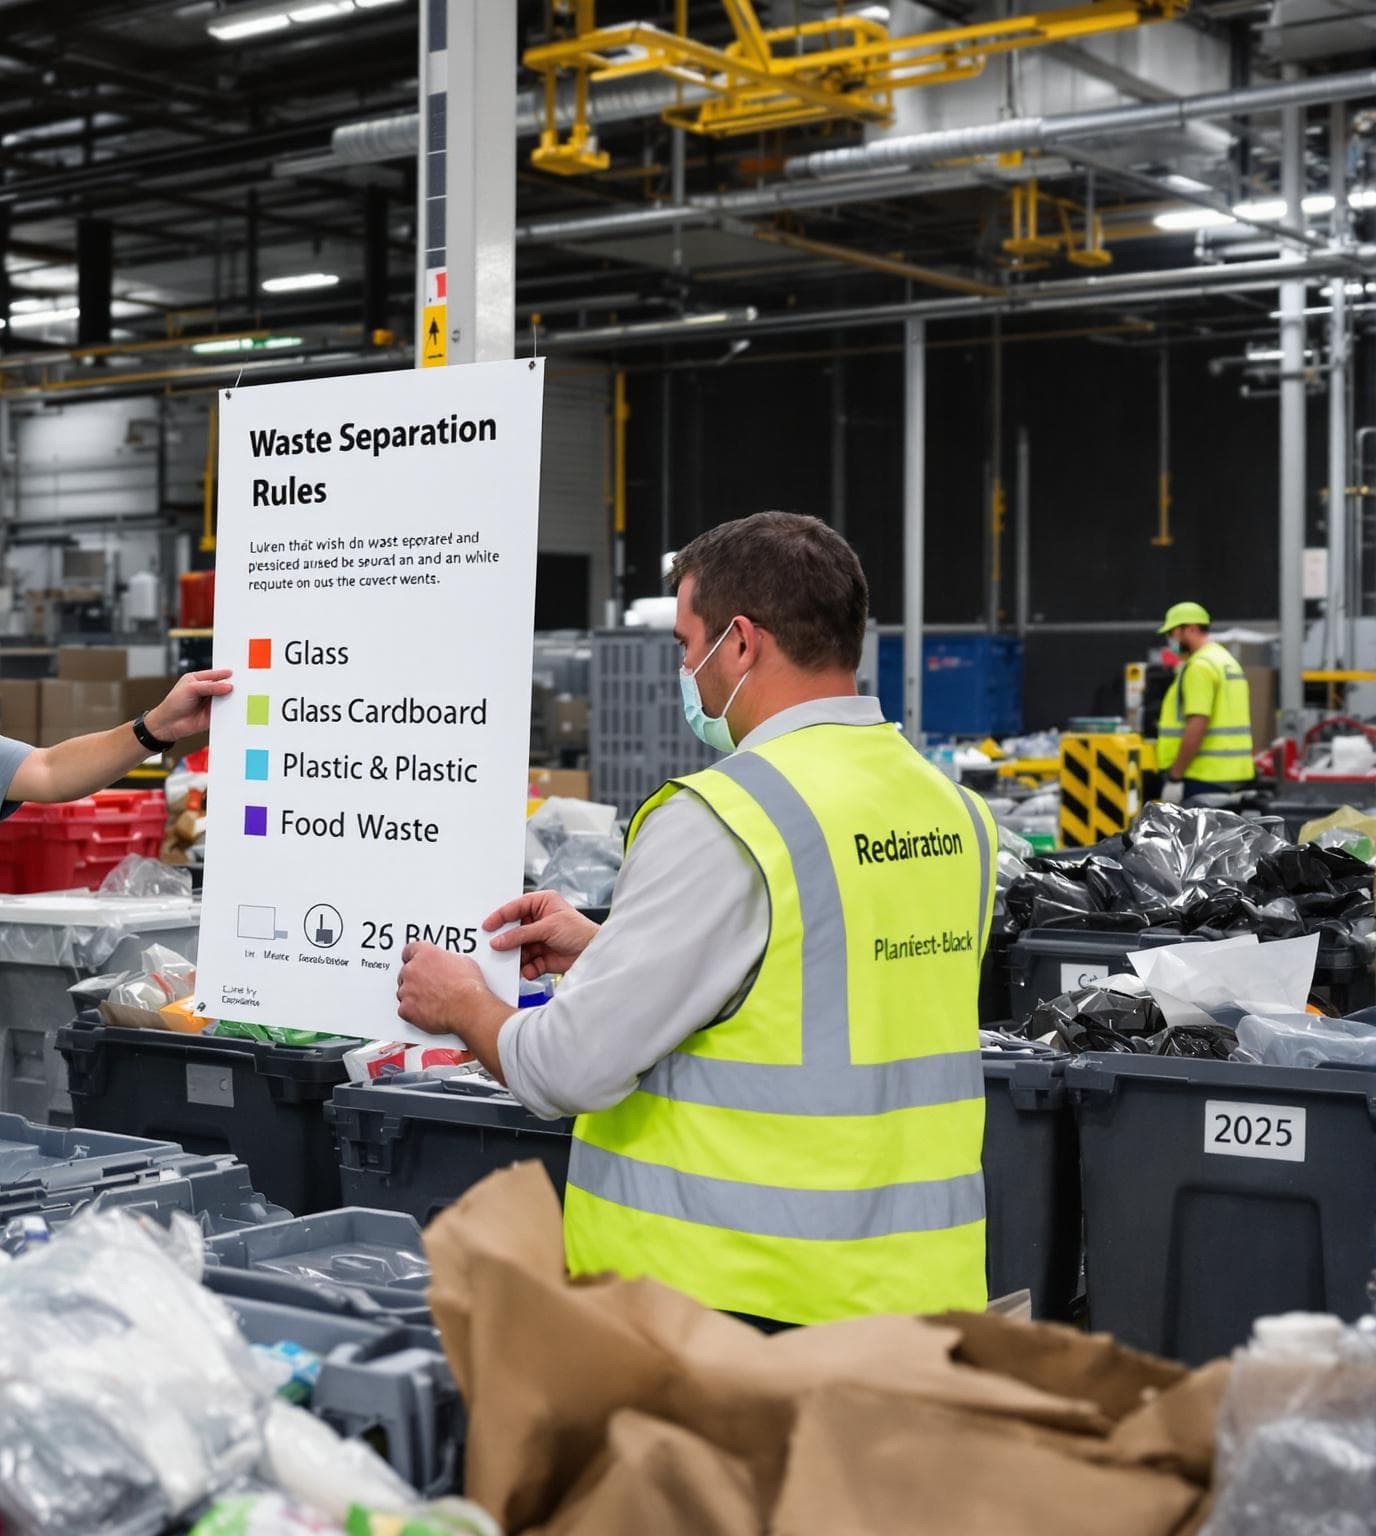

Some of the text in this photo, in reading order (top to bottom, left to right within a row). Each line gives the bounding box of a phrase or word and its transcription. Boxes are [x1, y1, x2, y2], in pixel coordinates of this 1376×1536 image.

[250, 414, 497, 457] Waste Separation
[252, 476, 327, 506] Rules
[289, 539, 313, 551] that
[316, 537, 345, 550] wish
[456, 531, 479, 544] and
[399, 556, 414, 566] an
[418, 552, 441, 565] and
[445, 554, 461, 564] an
[465, 550, 500, 564] white
[296, 579, 310, 589] on
[337, 576, 356, 587] the
[284, 640, 349, 665] Glass
[281, 696, 487, 725] Glass Cardboard
[284, 752, 478, 783] Plastic & Plastic
[281, 810, 439, 842] Food Waste
[854, 827, 963, 865] Redairation
[360, 921, 394, 950] 26
[1214, 1114, 1293, 1147] 2025
